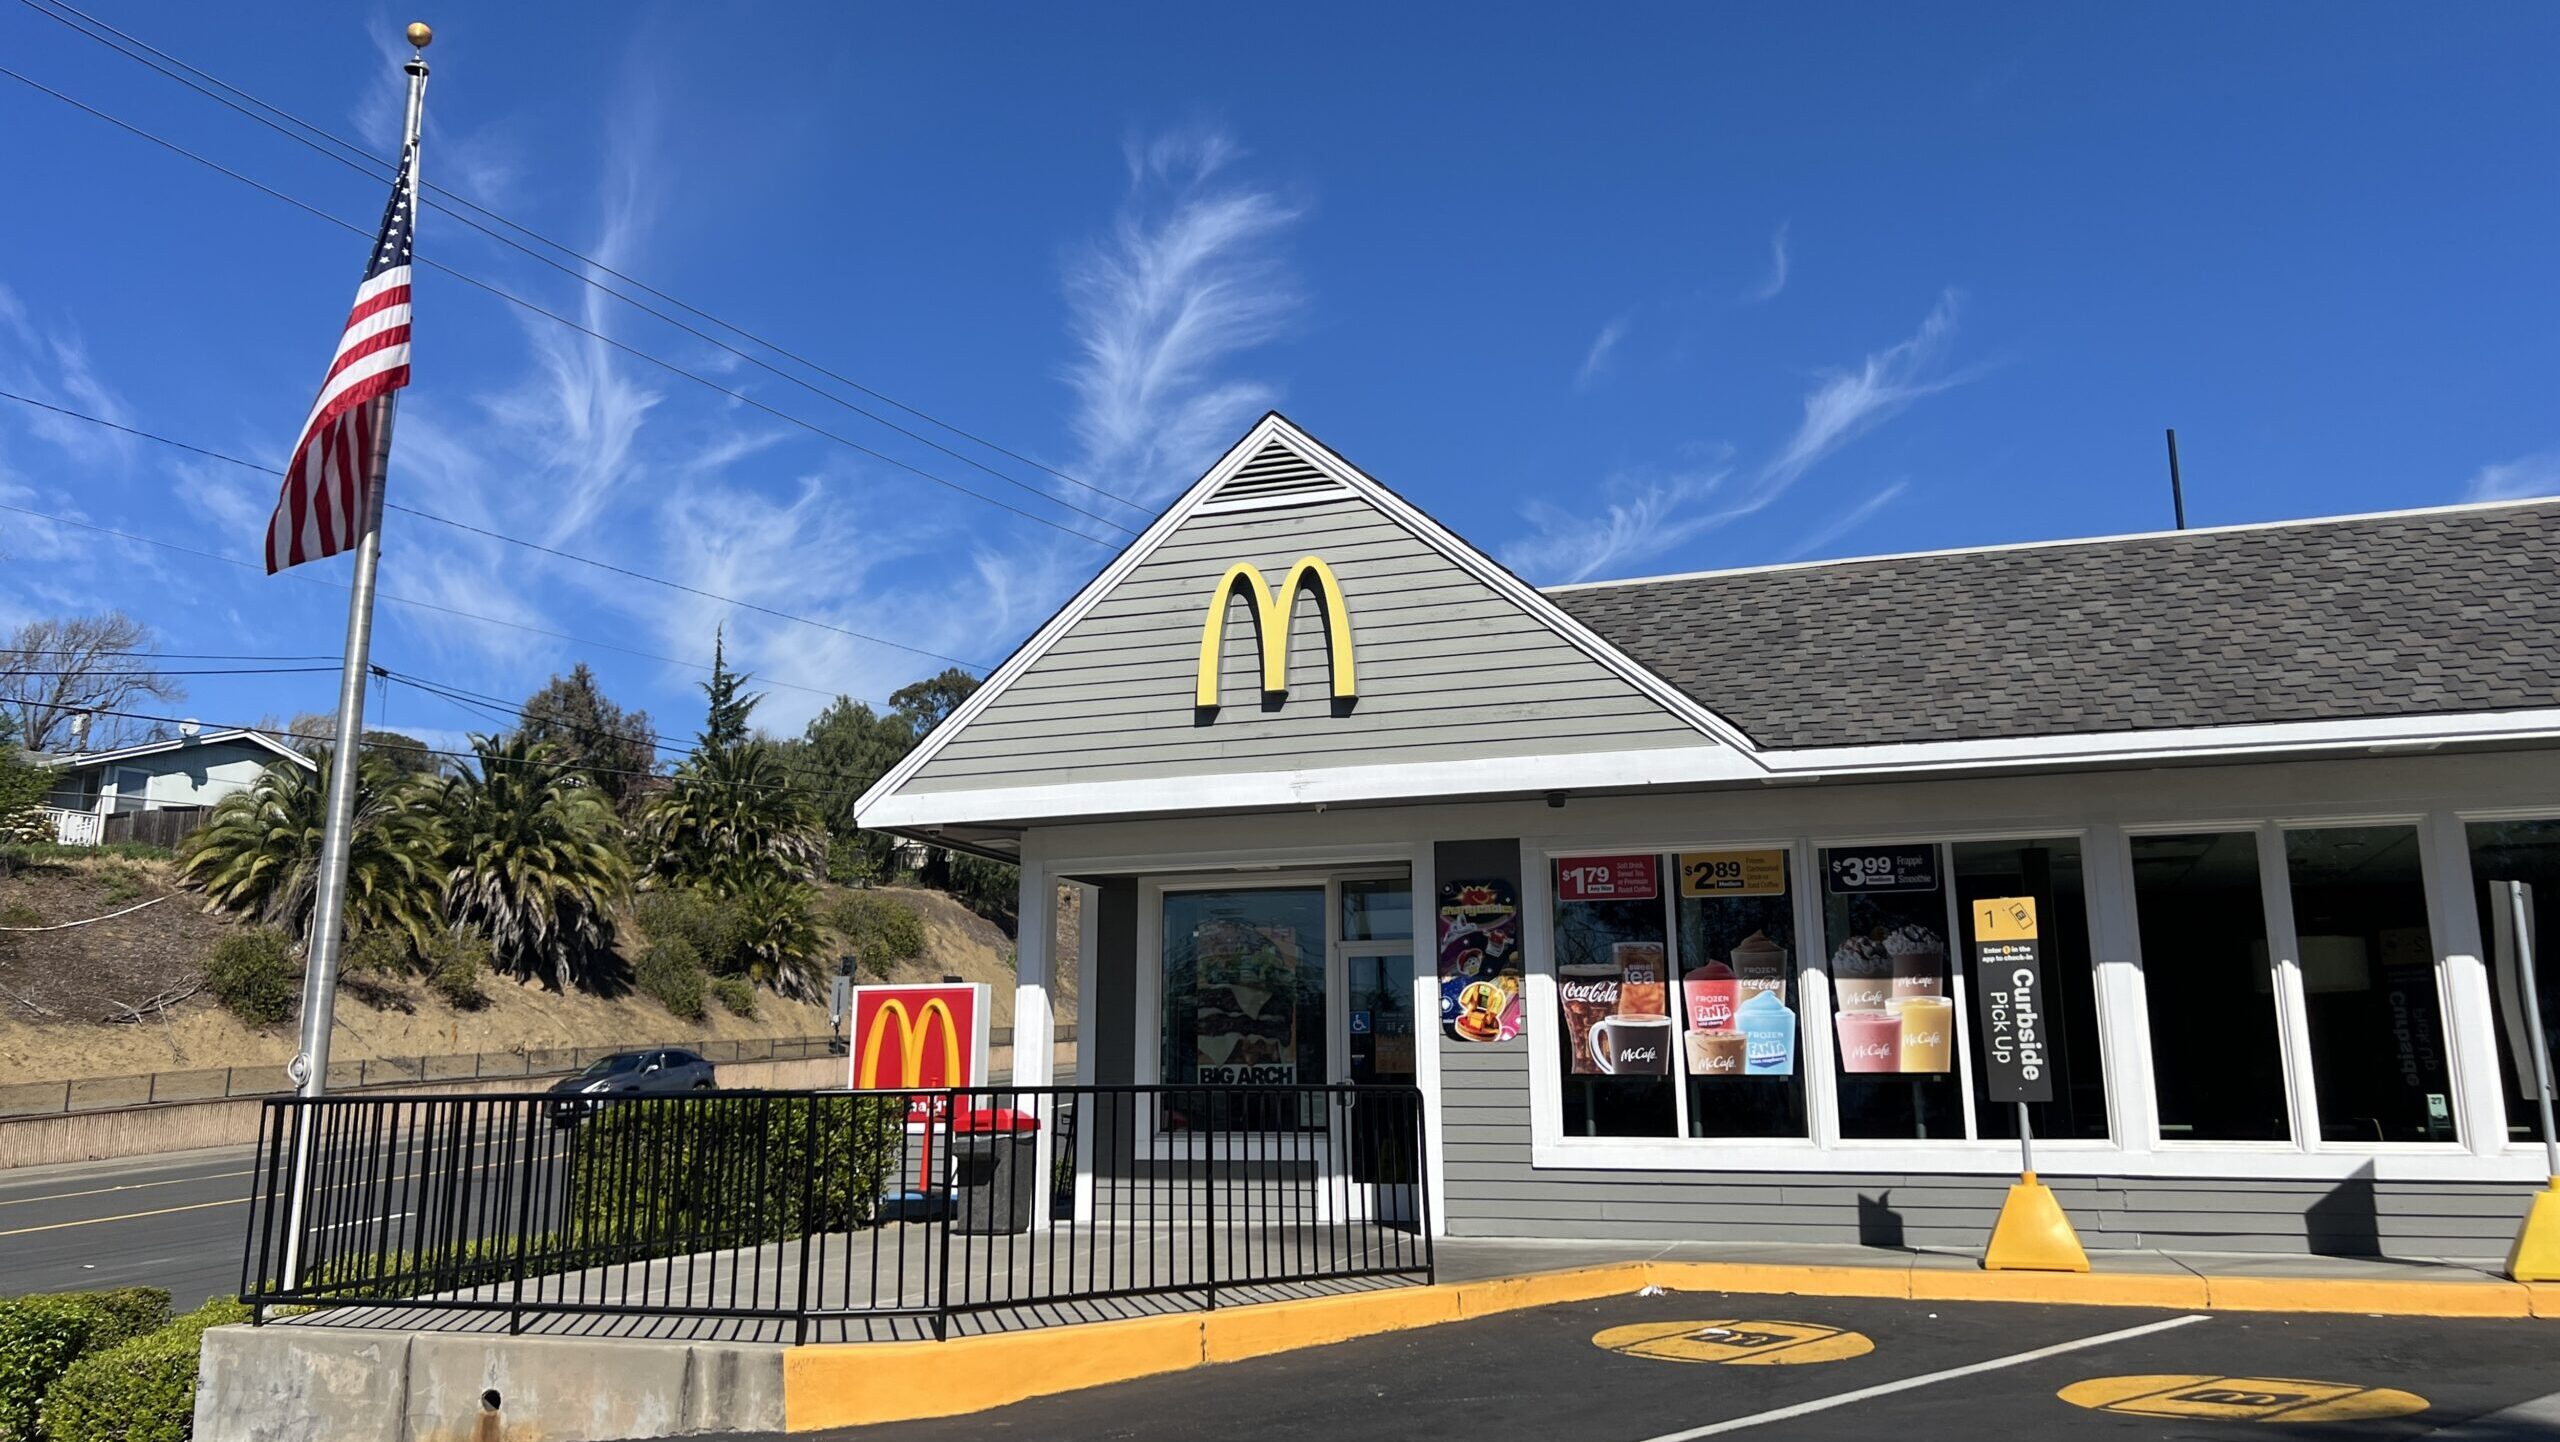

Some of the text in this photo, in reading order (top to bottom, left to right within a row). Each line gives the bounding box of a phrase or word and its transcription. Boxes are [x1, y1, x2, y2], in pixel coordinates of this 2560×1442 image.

[1984, 910, 1993, 928] 1
[1624, 967, 1655, 984] tea
[1563, 981, 1618, 1004] Coca-Cola
[1695, 1004, 1731, 1019] FANTA
[1990, 992, 2013, 1063] Pick Up
[2012, 968, 2043, 1081] Curbside
[1748, 1031, 1783, 1039] FROZEN
[1621, 1047, 1657, 1063] McCafé
[1852, 1043, 1890, 1059] McCafé
[1699, 1055, 1735, 1071] McCafé
[1200, 1066, 1293, 1084] BIG ARCH
